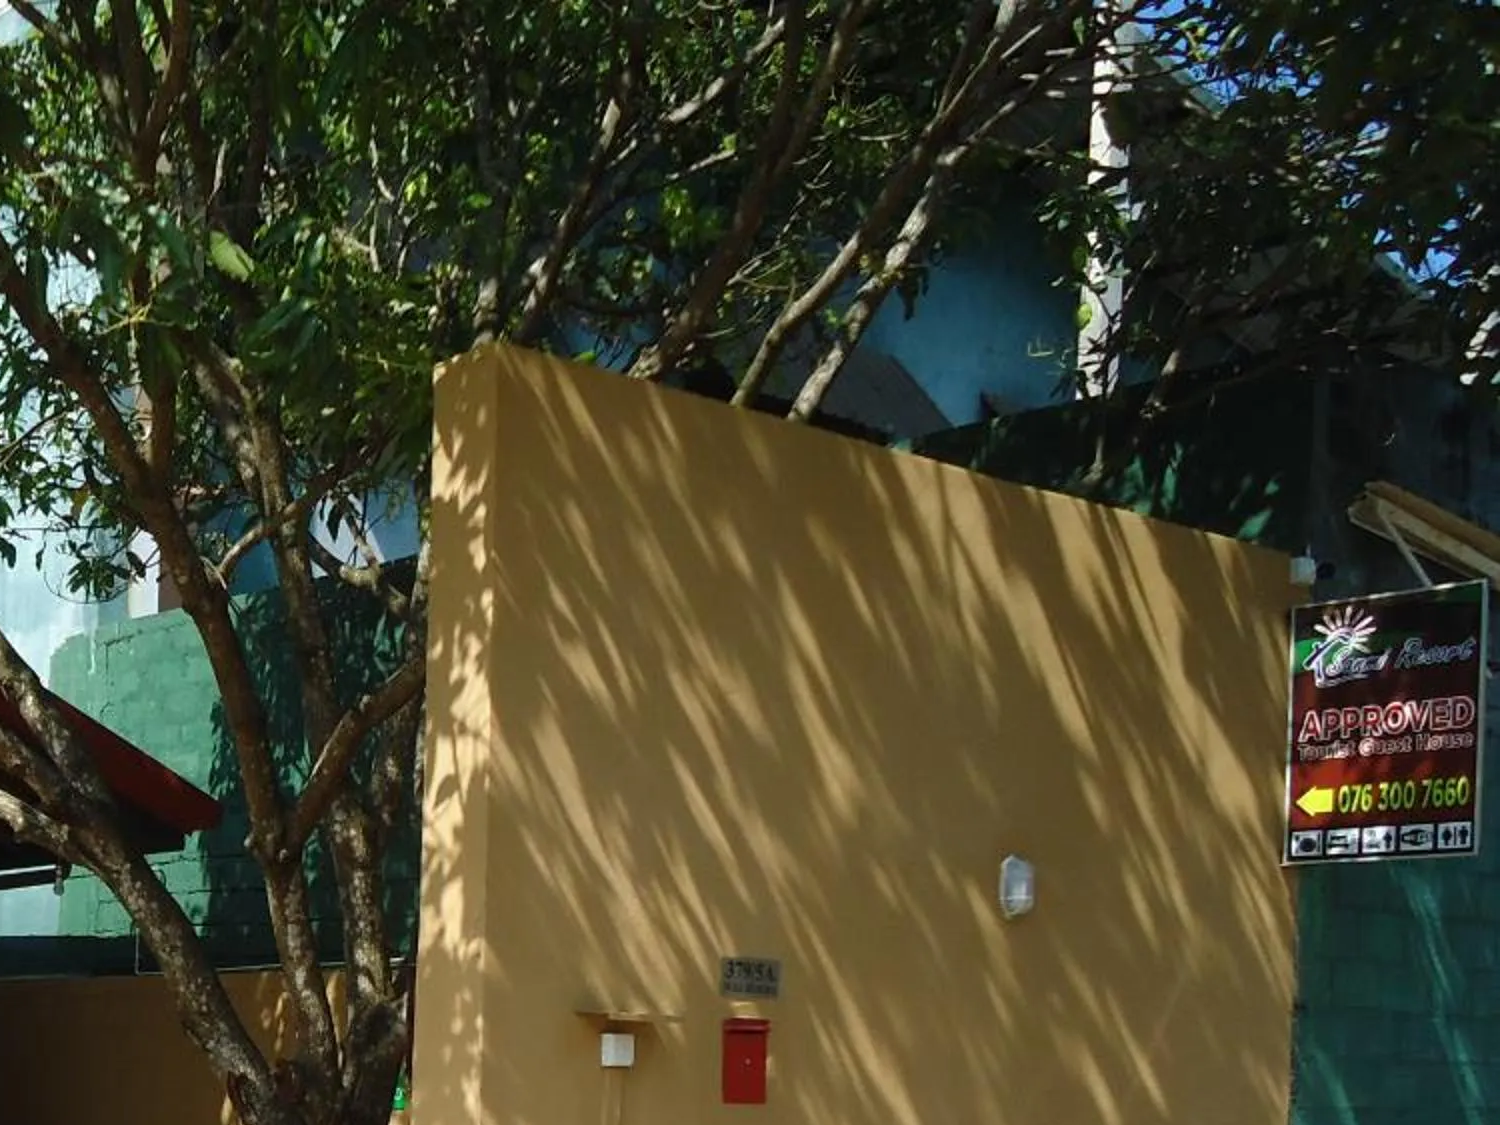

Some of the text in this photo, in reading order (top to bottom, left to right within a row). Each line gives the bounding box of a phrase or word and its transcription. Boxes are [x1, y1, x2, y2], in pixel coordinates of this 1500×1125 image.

[1297, 695, 1476, 742] APPROVED
[1298, 731, 1474, 762] Tourist Guest House
[1337, 776, 1471, 814] 076 300 7660
